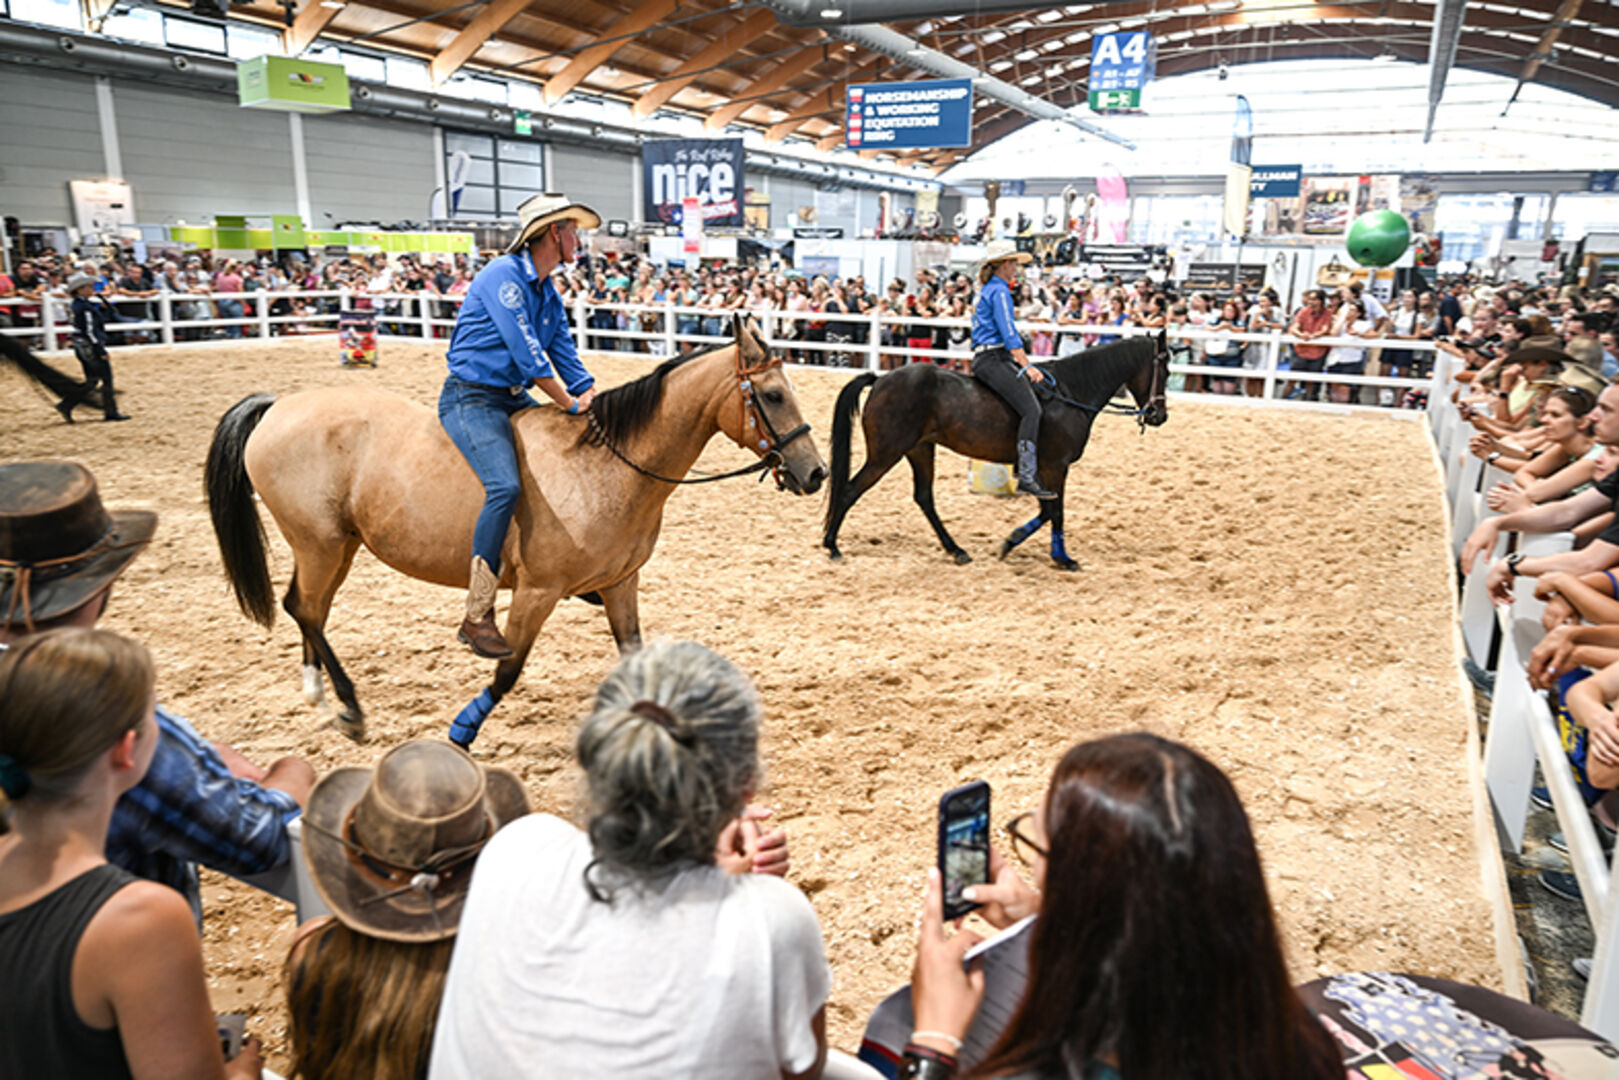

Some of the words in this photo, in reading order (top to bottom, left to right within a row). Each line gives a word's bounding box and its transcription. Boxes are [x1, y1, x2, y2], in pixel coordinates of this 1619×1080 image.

[1092, 32, 1147, 66] A4
[865, 88, 968, 103] HORSEMANSHIP
[864, 106, 875, 116] &
[876, 102, 940, 116] WORKING
[864, 115, 940, 130] EQUITATION
[863, 130, 896, 142] RING
[653, 163, 735, 206] nice
